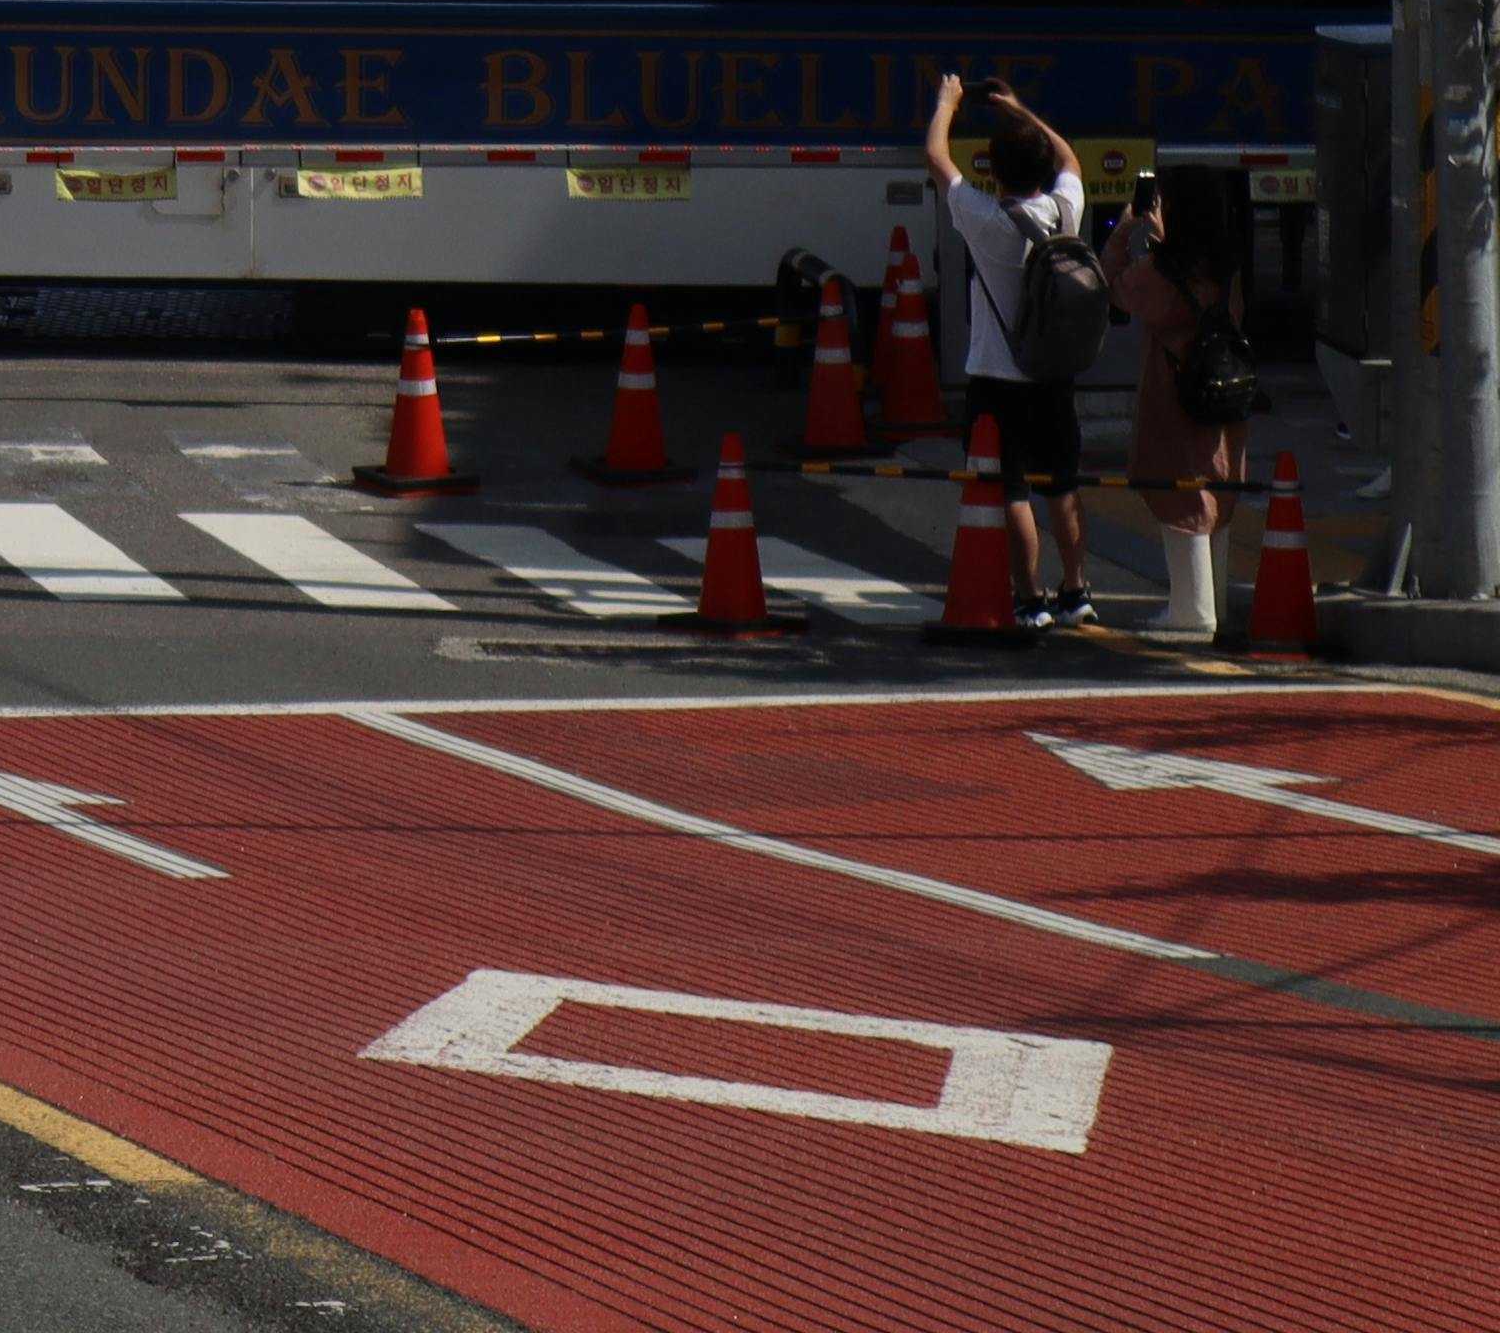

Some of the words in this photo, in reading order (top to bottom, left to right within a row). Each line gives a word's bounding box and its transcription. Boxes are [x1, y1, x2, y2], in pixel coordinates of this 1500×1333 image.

[1131, 53, 1315, 136] PA
[85, 176, 168, 195] 일단정지
[330, 175, 413, 193] 일단정지
[595, 173, 683, 196] 일단정지
